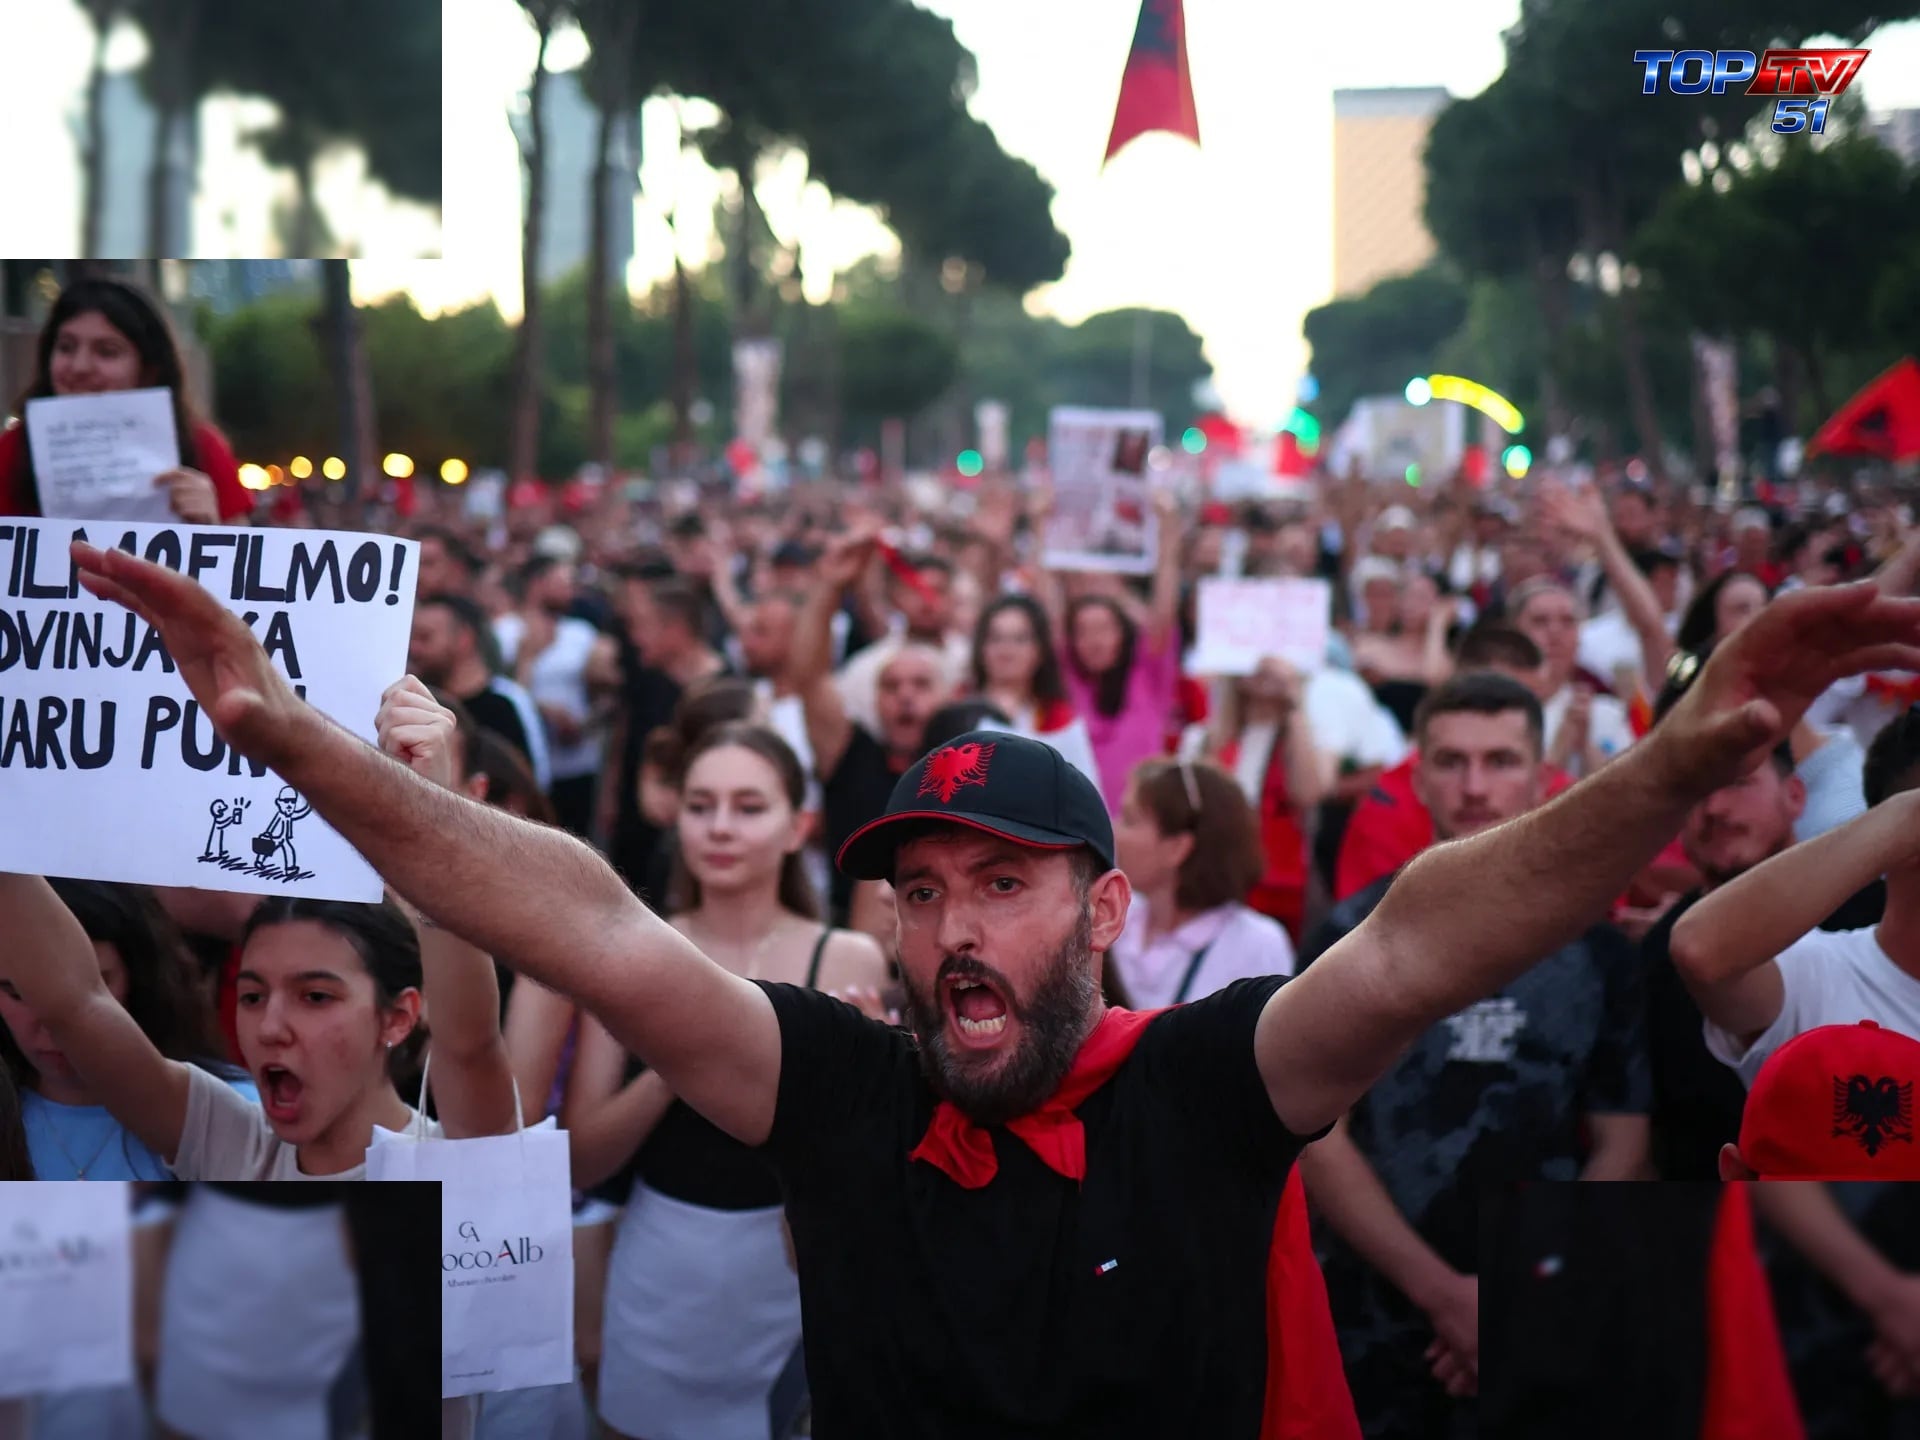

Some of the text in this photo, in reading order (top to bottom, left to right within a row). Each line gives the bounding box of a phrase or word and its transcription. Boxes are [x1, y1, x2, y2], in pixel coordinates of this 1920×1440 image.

[241, 611, 302, 679] A
[0, 685, 306, 777] ARU PU
